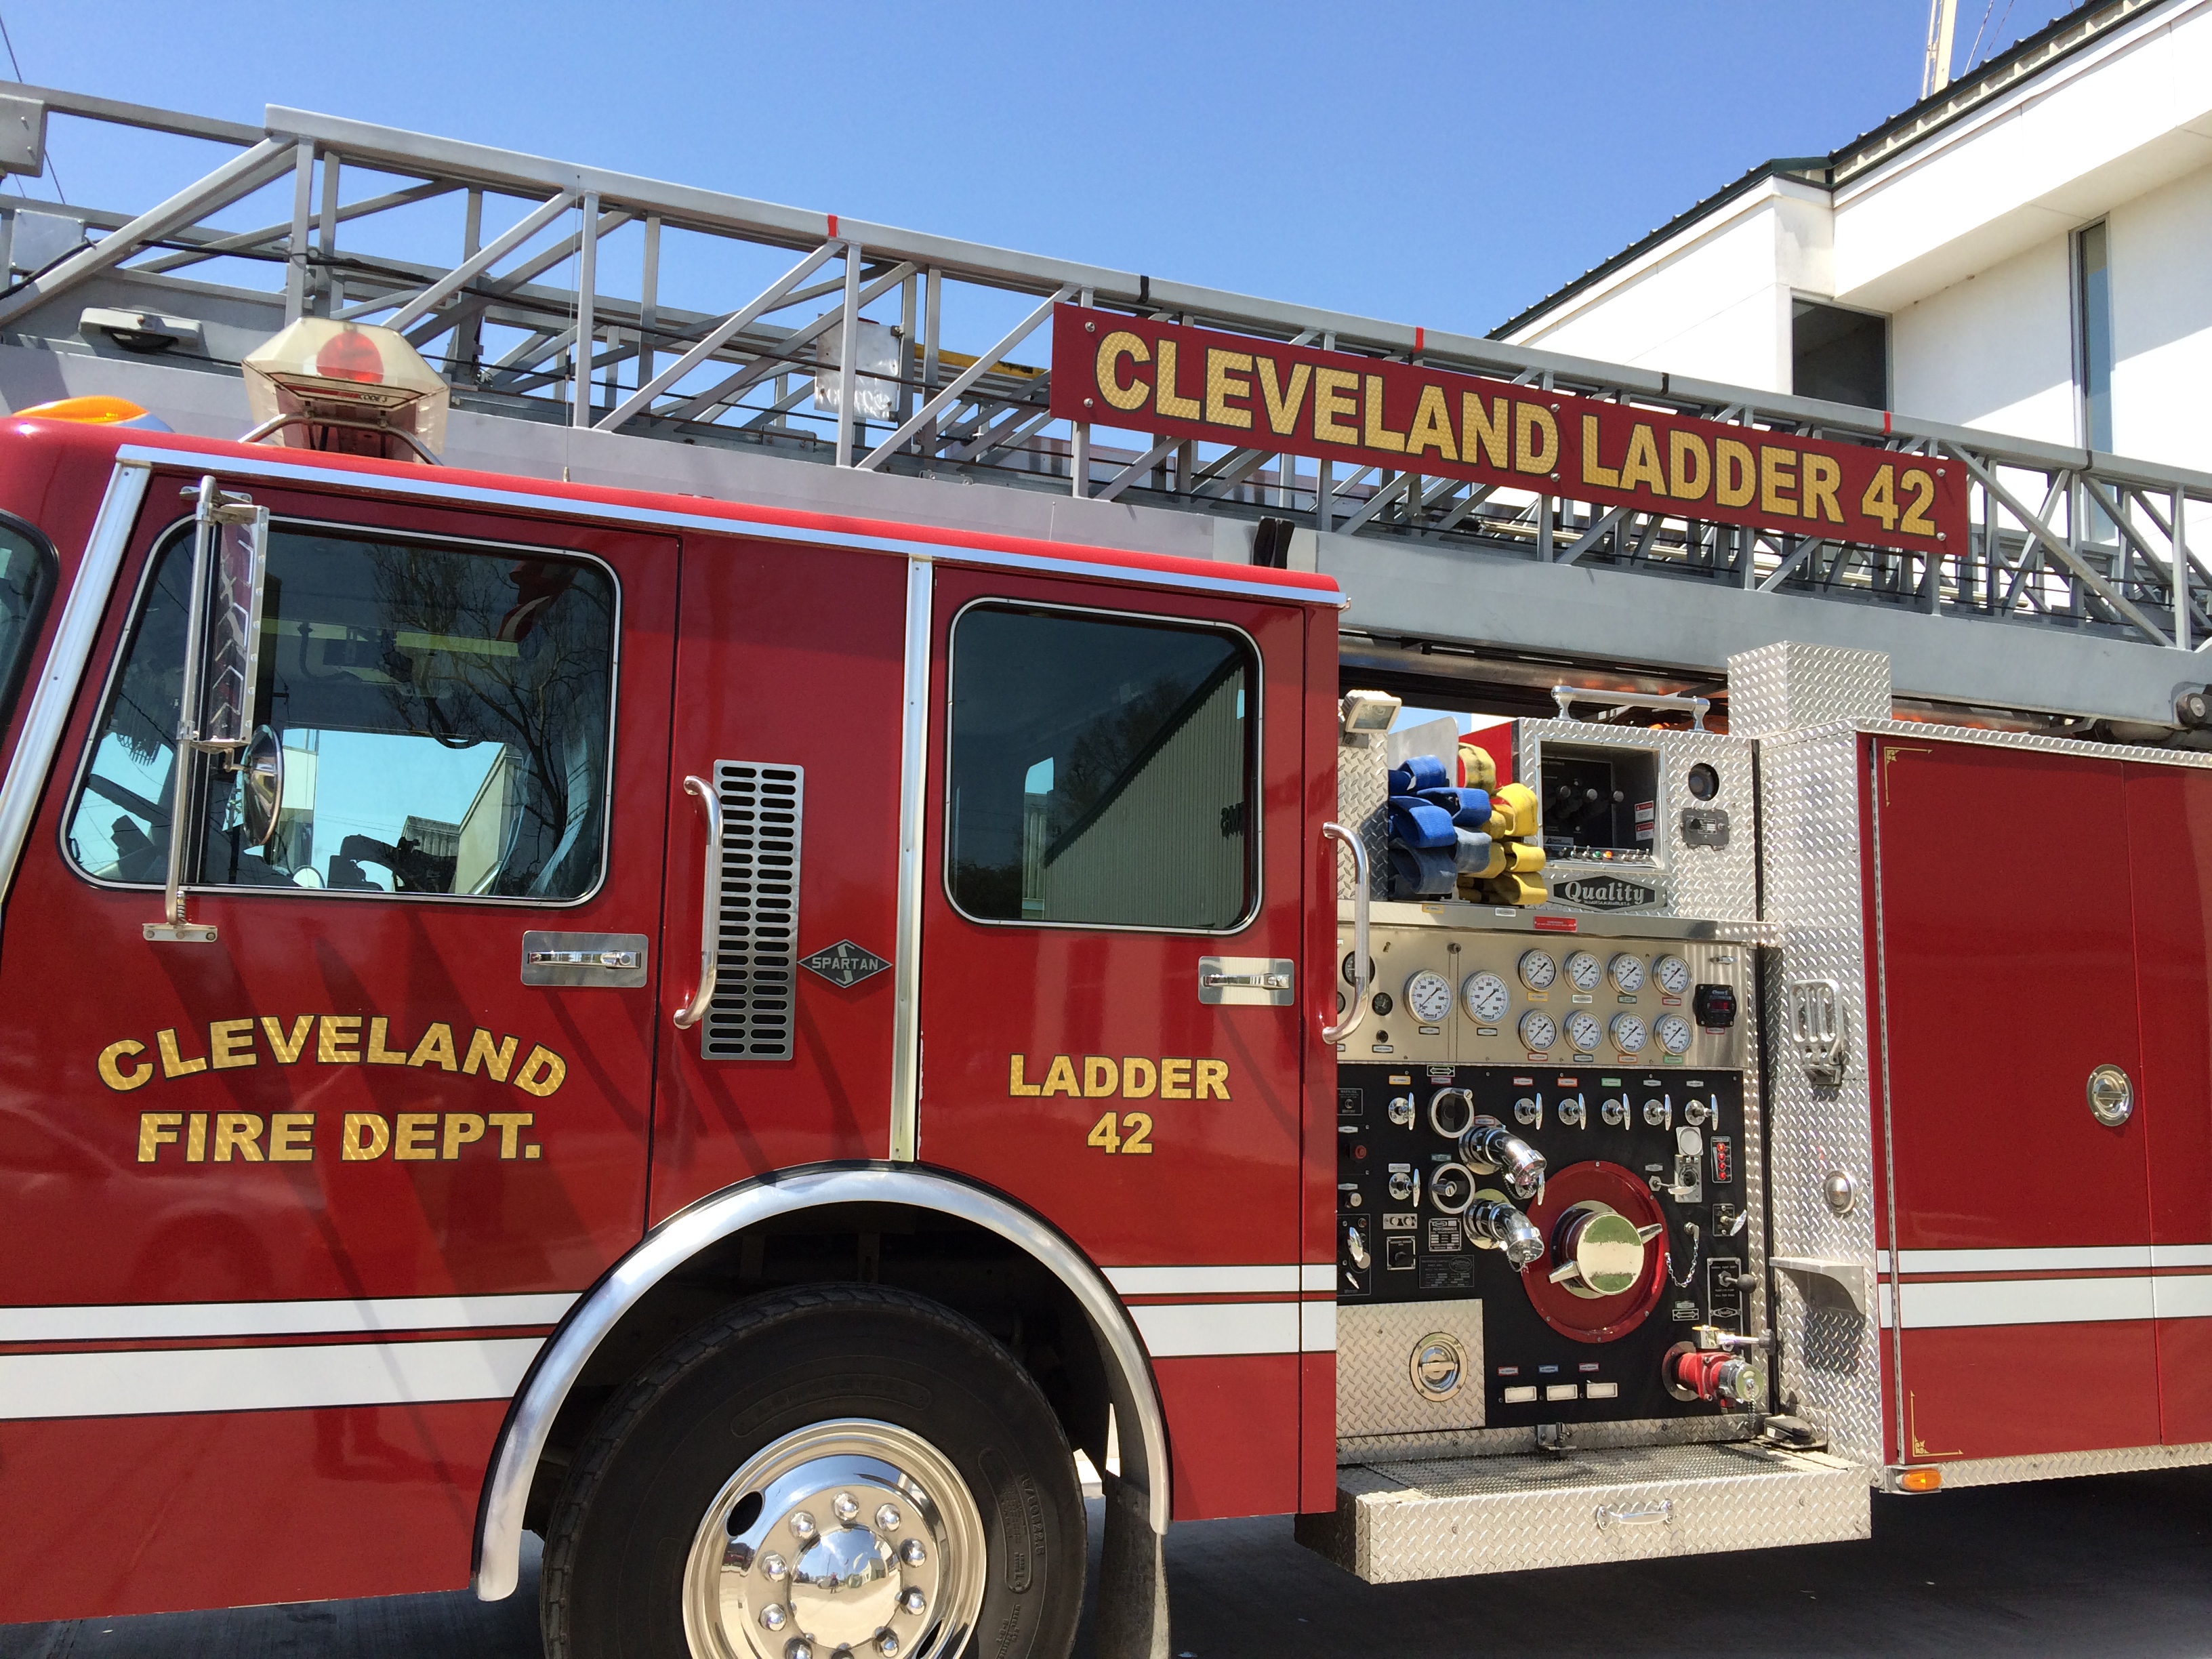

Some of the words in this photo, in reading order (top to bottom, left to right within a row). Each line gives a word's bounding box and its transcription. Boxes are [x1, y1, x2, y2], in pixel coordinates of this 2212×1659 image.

[1094, 329, 1559, 476] CLEVELAND
[1581, 413, 1845, 524] LADDER
[1860, 464, 1936, 537] 42
[1565, 881, 1645, 904] Quality
[812, 957, 879, 970] SPARTAN
[96, 1014, 569, 1098] CLEVELAND
[1009, 1053, 1232, 1101] LADDER
[136, 1111, 316, 1163] FIRE
[340, 1111, 542, 1162] DEPT.
[1086, 1111, 1153, 1155] 42
